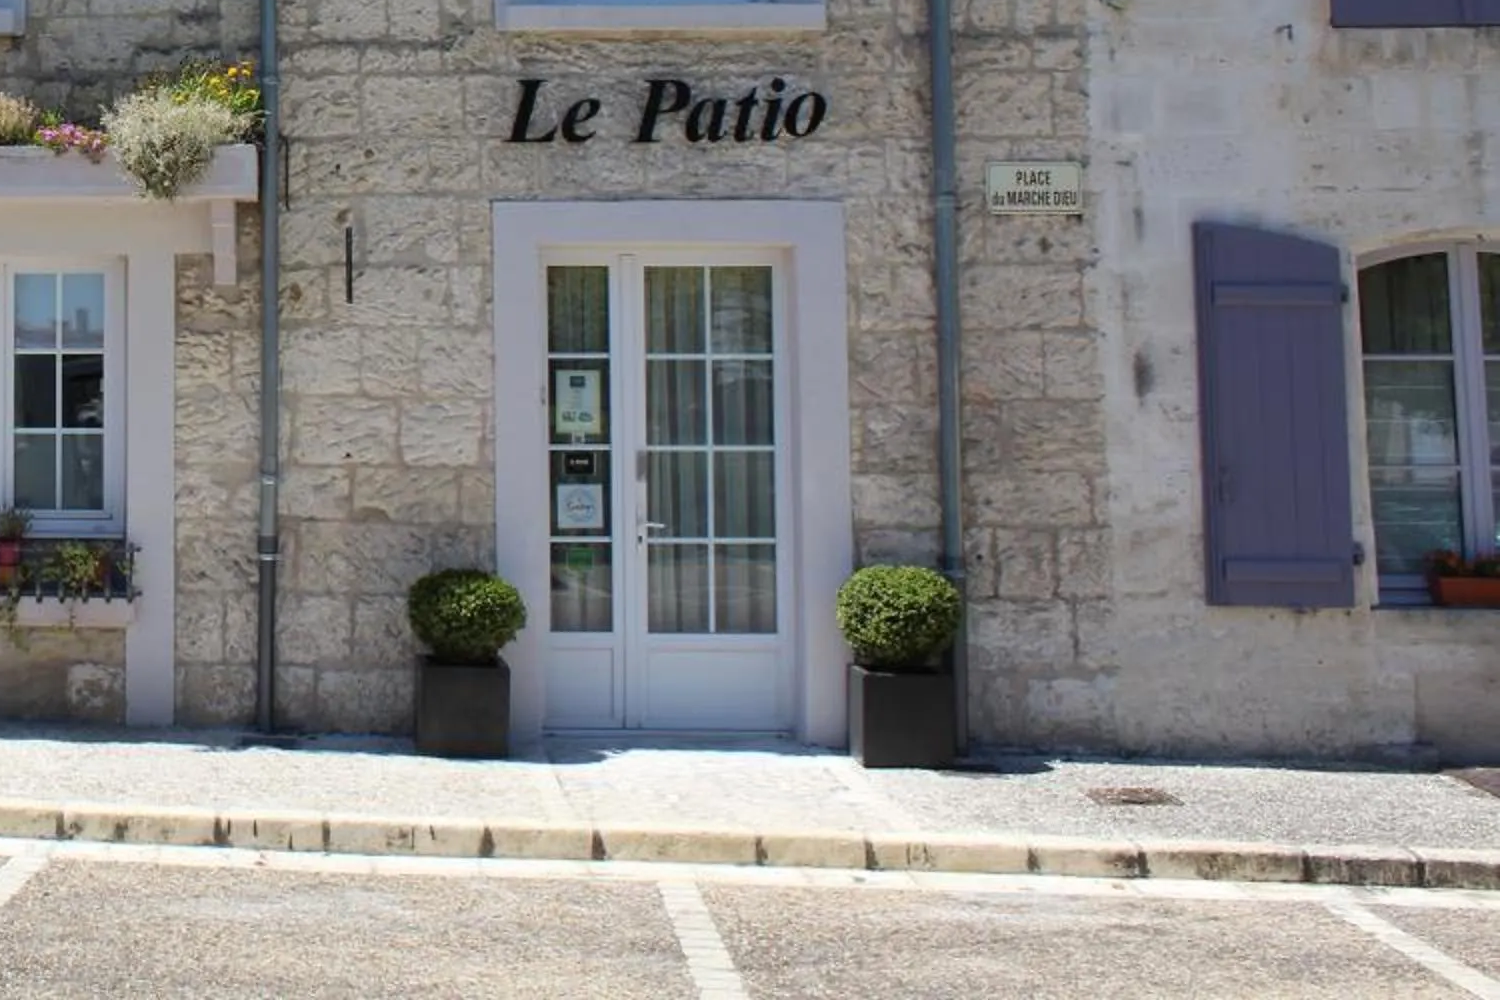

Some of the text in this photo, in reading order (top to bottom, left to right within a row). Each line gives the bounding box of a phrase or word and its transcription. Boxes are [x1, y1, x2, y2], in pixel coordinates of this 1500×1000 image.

[503, 77, 827, 144] Le Patio
[1016, 170, 1051, 185] PLACE
[1007, 191, 1052, 206] MARCHE
[1054, 191, 1077, 206] DIEU
